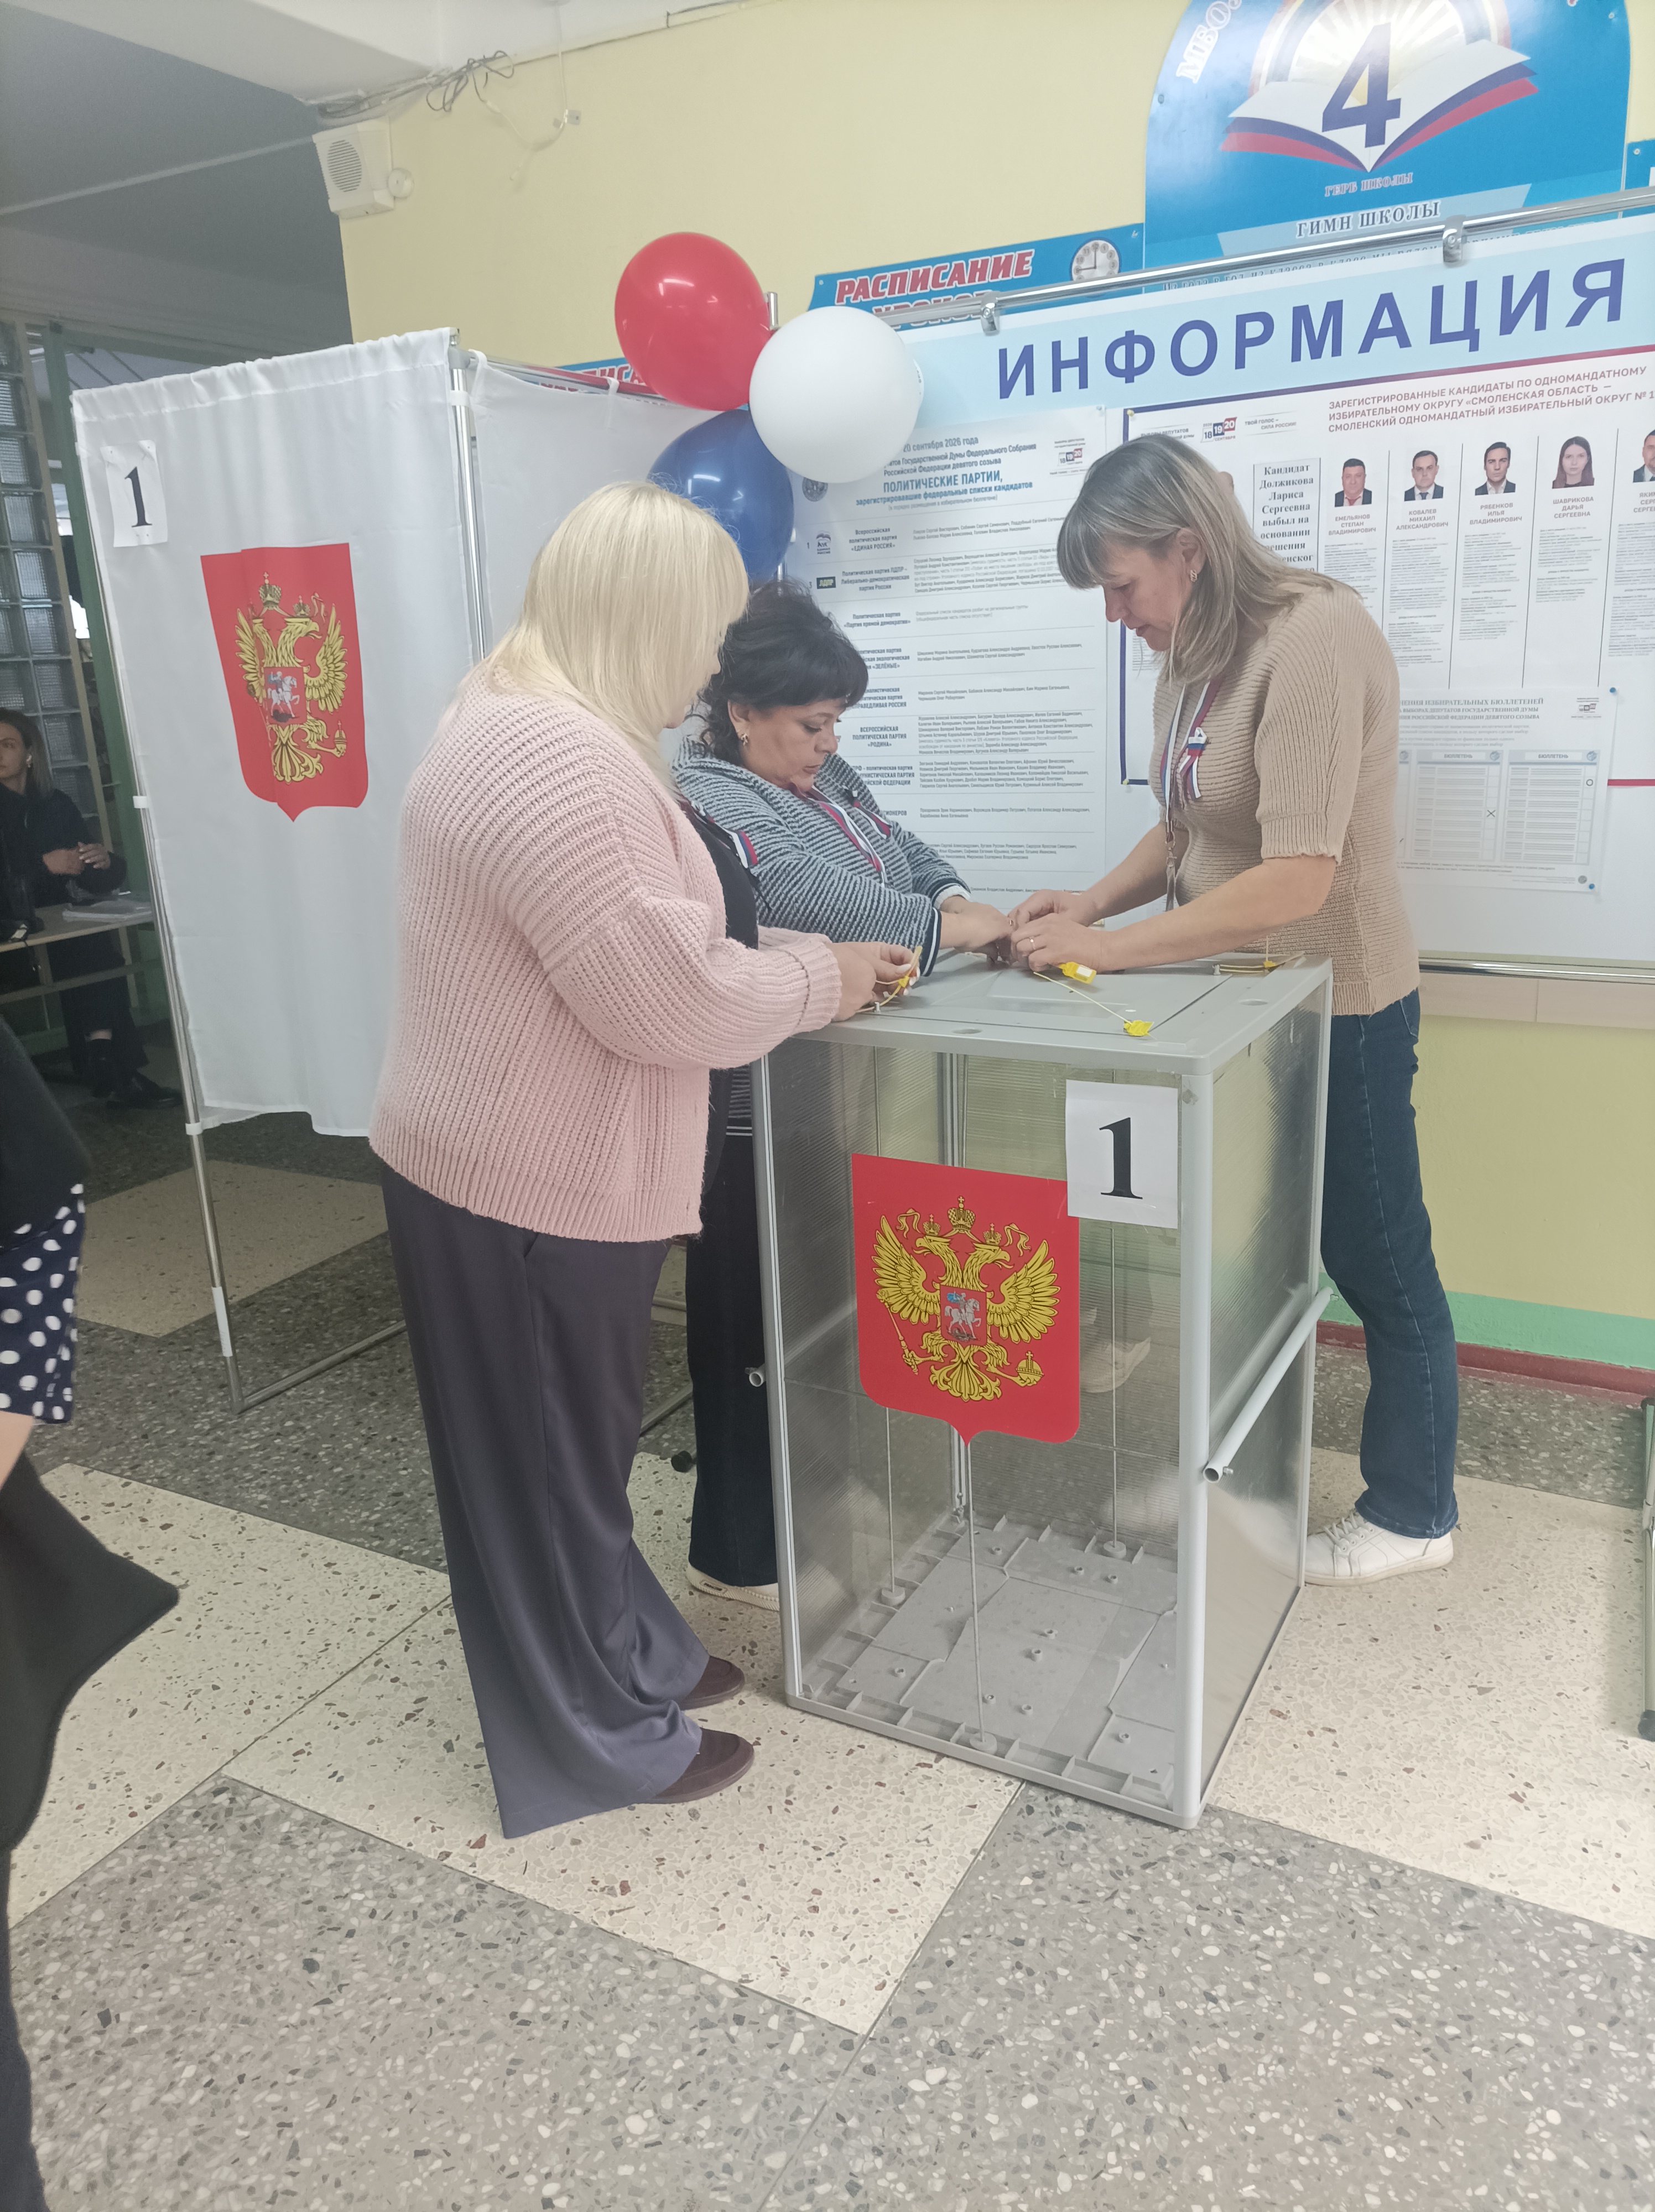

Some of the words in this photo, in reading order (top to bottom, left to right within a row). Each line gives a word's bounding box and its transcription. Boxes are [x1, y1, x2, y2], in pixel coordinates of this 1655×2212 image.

[1176, 0, 1242, 84] МБО
[1322, 24, 1401, 148] 4
[1324, 181, 1357, 197] ГЕРБ
[1361, 173, 1413, 191] ШКОЛЫ
[1297, 215, 1352, 238] ГИМН
[1360, 201, 1440, 228] ШКОЛЫ
[836, 250, 1034, 304] РАСПИСАНИЕ
[998, 258, 1625, 399] ИНФОРМАЦИЯ
[1329, 389, 1445, 409] ЗАРЕГИСТРИРОВАННЫЕ
[1449, 381, 1514, 395] КАНДИДАТЫ
[1517, 379, 1531, 388] ПО
[1534, 366, 1647, 386] ОДНОМАНДАТНОМУ
[1329, 403, 1420, 421] ИЗБИРАТЕЛЬНОМУ
[1423, 399, 1464, 410] ОКРУГУ
[1466, 389, 1544, 405] «СМОЛЕНСКАЯ
[1547, 384, 1598, 397] ОБЛАСТЬ
[1329, 416, 1396, 432] СМОЛЕНСКИЙ
[1399, 405, 1495, 425] ОДНОМАНДАТНЫЙ
[1498, 395, 1592, 414] ИЗБИРАТЕЛЬНЫЙ
[1595, 393, 1632, 405] ОКРУГ
[1635, 391, 1647, 400] №
[1649, 390, 1655, 399] 1
[1214, 426, 1222, 434] 19
[1225, 420, 1234, 429] 20
[902, 452, 948, 466] Государственной
[949, 451, 965, 461] Думы
[966, 446, 1007, 458] Федерального
[1008, 444, 1037, 453] Собрания
[913, 441, 943, 451] сентября
[945, 437, 961, 447] 2026
[962, 437, 979, 446] года
[884, 468, 917, 477] Российской
[918, 463, 951, 473] Федерации
[952, 461, 978, 470] девятого
[980, 458, 1001, 466] созыва
[1264, 465, 1310, 476] Кандидат
[883, 474, 958, 493] ПОЛИТИЧЕСКИЕ
[962, 470, 1003, 484] ПАРТИИ,
[1260, 477, 1314, 490] Должикова
[125, 467, 152, 528] 1
[856, 493, 922, 505] зарегистрировавшие
[923, 487, 968, 500] федеральные
[970, 486, 992, 494] списки
[994, 481, 1033, 492] кандидатов
[1268, 491, 1304, 502] Лариса
[1262, 504, 1310, 515] Сергеевна
[1263, 517, 1295, 526] выбыл
[1396, 522, 1449, 530] АЛЕКСАНДРОВИЧ
[1469, 517, 1522, 525] ВЛАДИМИРОВИЧ
[1261, 529, 1310, 540] основании
[1099, 1117, 1143, 1199] 1
